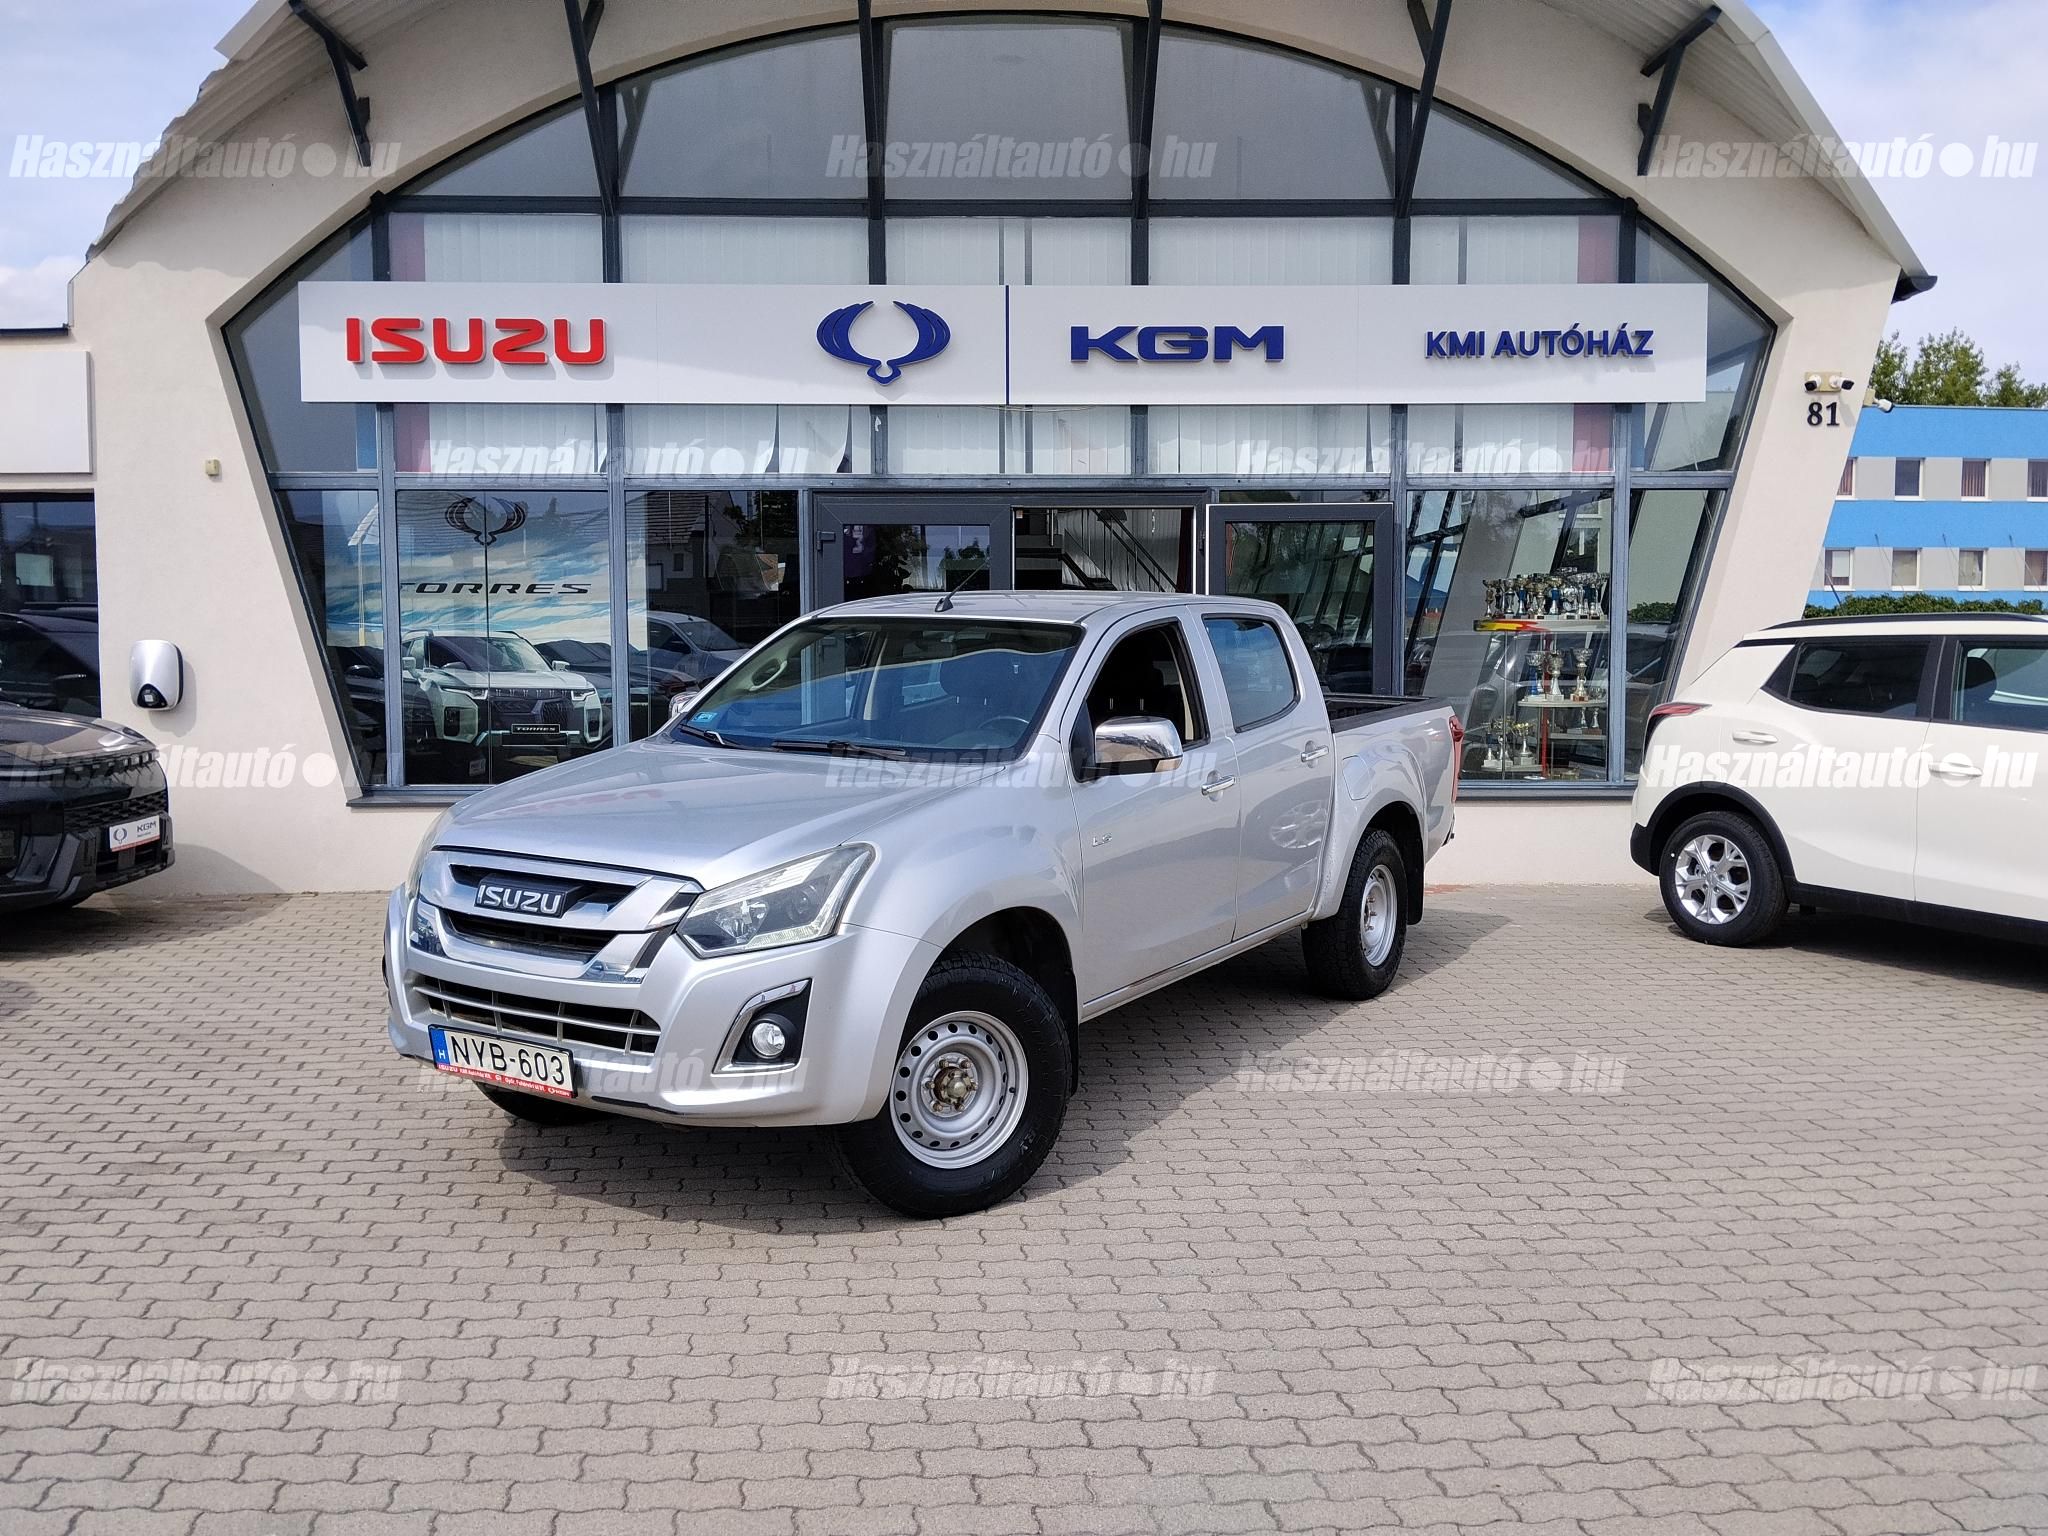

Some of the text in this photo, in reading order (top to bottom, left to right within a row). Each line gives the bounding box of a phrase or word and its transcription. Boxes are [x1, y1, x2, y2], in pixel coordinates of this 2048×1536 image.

[346, 318, 606, 363] ISUZU
[1071, 326, 1285, 361] KGM
[1425, 323, 1654, 357] KMI AUTÓHÁZ
[1807, 402, 1839, 426] 81
[136, 821, 157, 832] KGM
[477, 885, 561, 914] ISUZU
[438, 1049, 446, 1060] H
[451, 1036, 565, 1085] NYB-603
